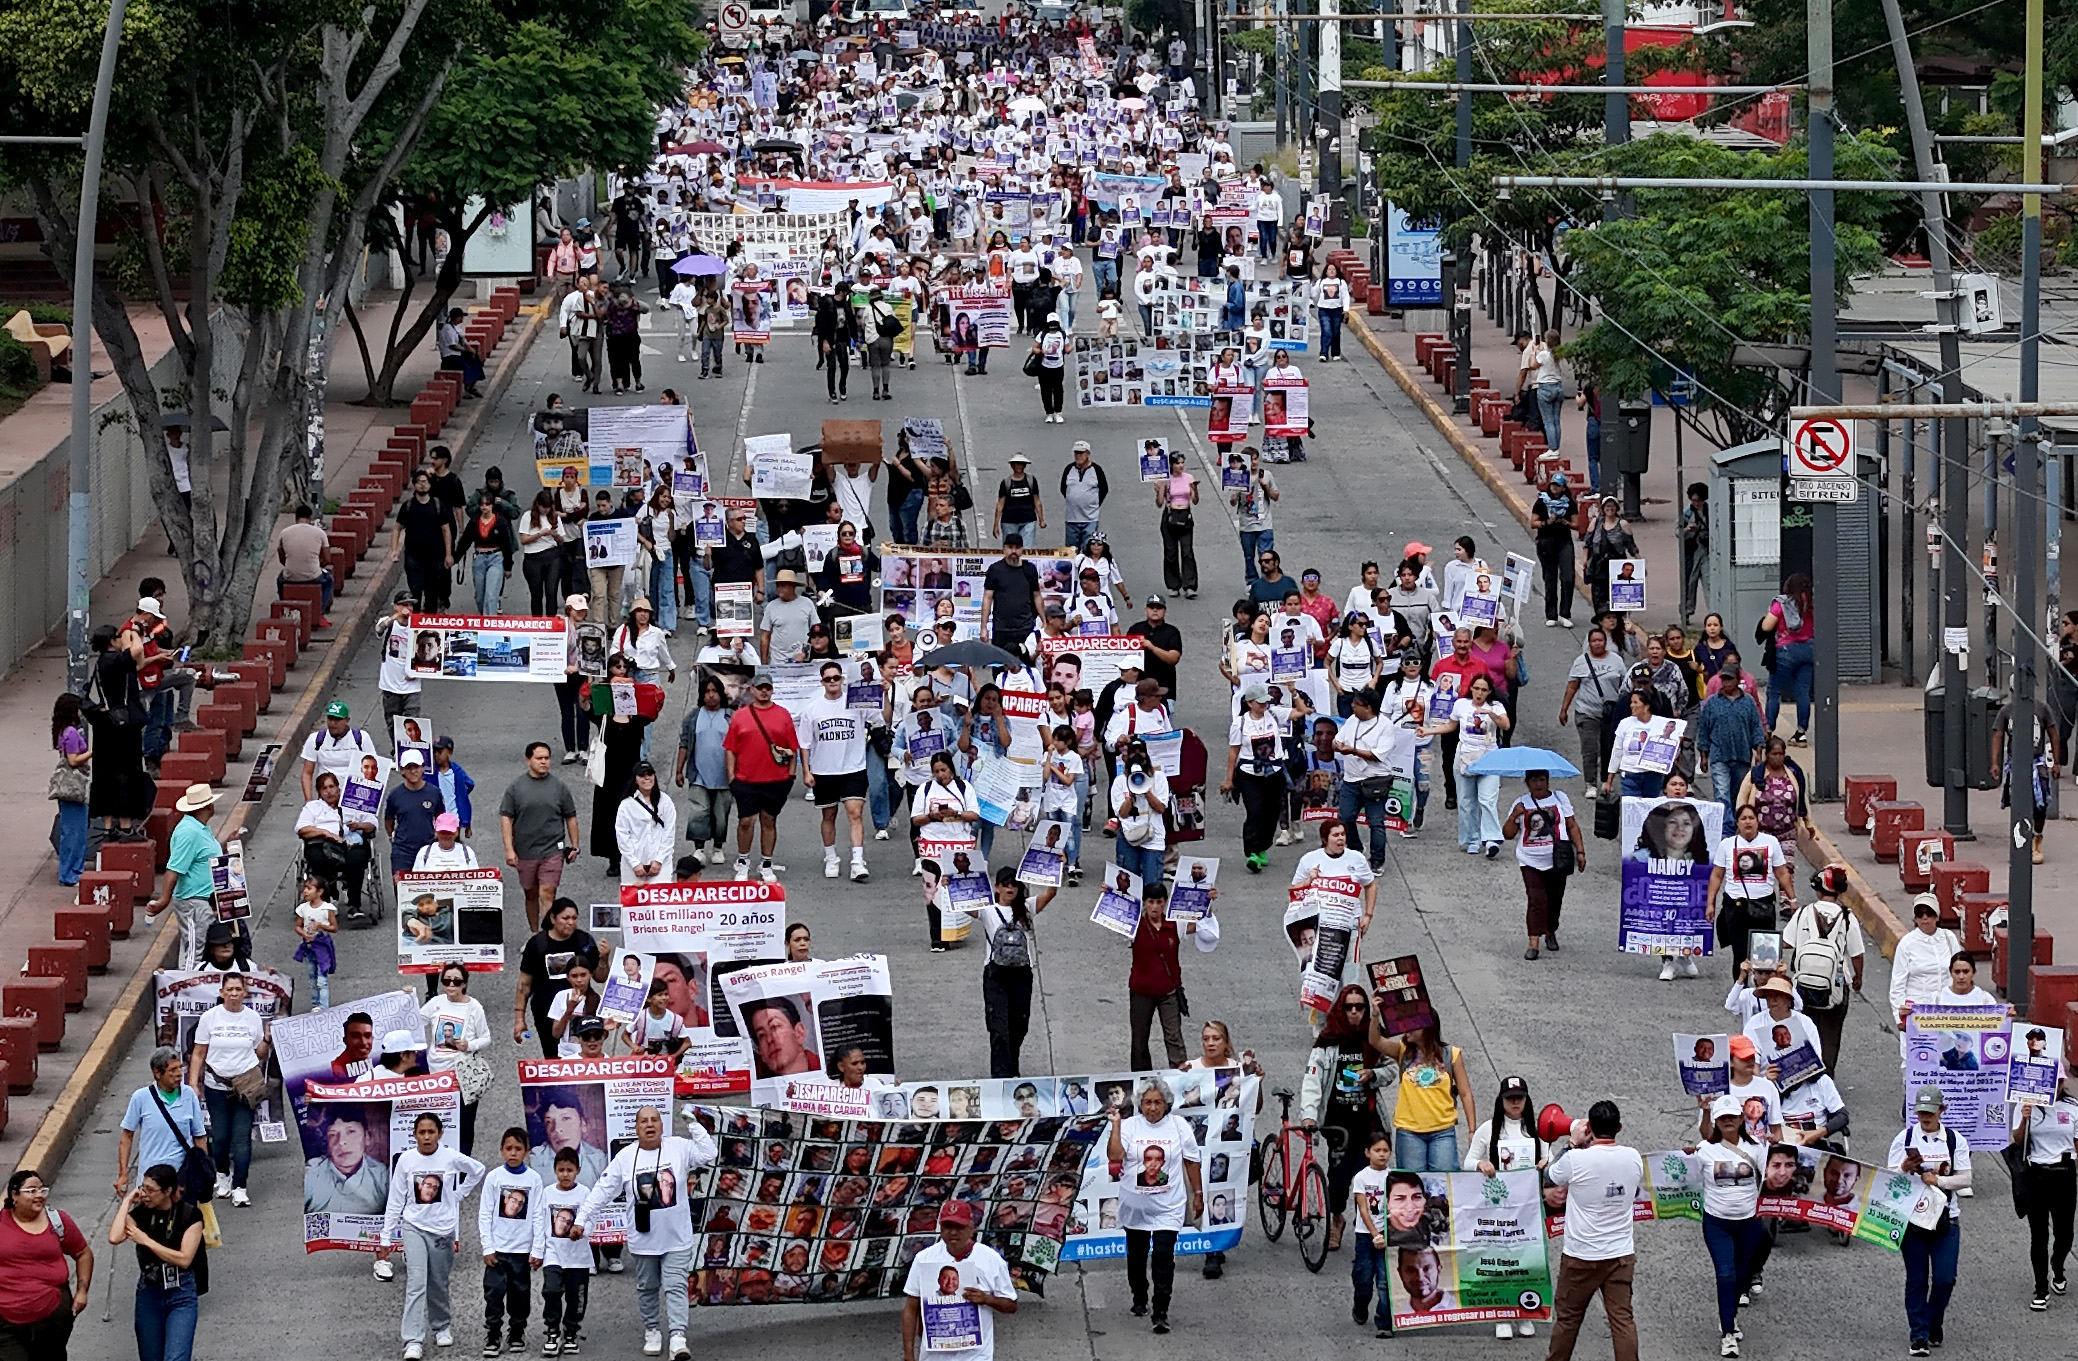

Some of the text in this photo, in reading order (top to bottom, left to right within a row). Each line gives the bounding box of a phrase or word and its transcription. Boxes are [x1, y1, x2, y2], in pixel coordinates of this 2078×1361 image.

[773, 262, 807, 270] HASTA
[950, 287, 962, 299] TE
[1817, 482, 1851, 491] ASCENSO
[1800, 491, 1851, 499] SITREN
[418, 618, 553, 630] JALISCO TE DESAPARECE
[1043, 638, 1141, 652] DESAPARECIDO
[818, 730, 855, 742] MADNESS
[1648, 858, 1695, 876] NANCY
[404, 870, 496, 880] DESAPARECIDO
[637, 886, 771, 904] DESAPARECIDO
[629, 908, 714, 922] Raúl Emiliano
[720, 912, 775, 926] 20 años
[1662, 909, 1677, 921] 30
[632, 924, 705, 935] Briones Rangel
[730, 964, 807, 987] Briones Rangel
[158, 974, 221, 999] GUERREROS
[524, 1060, 668, 1079] DESAPARECIDO
[314, 1075, 453, 1099] DESAPARECIDO
[612, 1080, 666, 1089] LUIS ANTONIO
[419, 1094, 453, 1104] ANTONIO
[793, 1082, 869, 1105] DESAPARECIDA
[818, 1103, 833, 1115] DEL
[834, 1104, 868, 1117] CARMEN
[1782, 1206, 1802, 1215] Torres
[1478, 1218, 1518, 1227] Omar Israel
[1833, 1216, 1854, 1228] Torres
[1502, 1228, 1526, 1237] Torres
[1480, 1258, 1520, 1267] José Carlos
[1504, 1269, 1530, 1277] Torres
[1444, 1312, 1479, 1322] regresar
[1486, 1310, 1497, 1318] mi
[1498, 1310, 1516, 1318] casa
